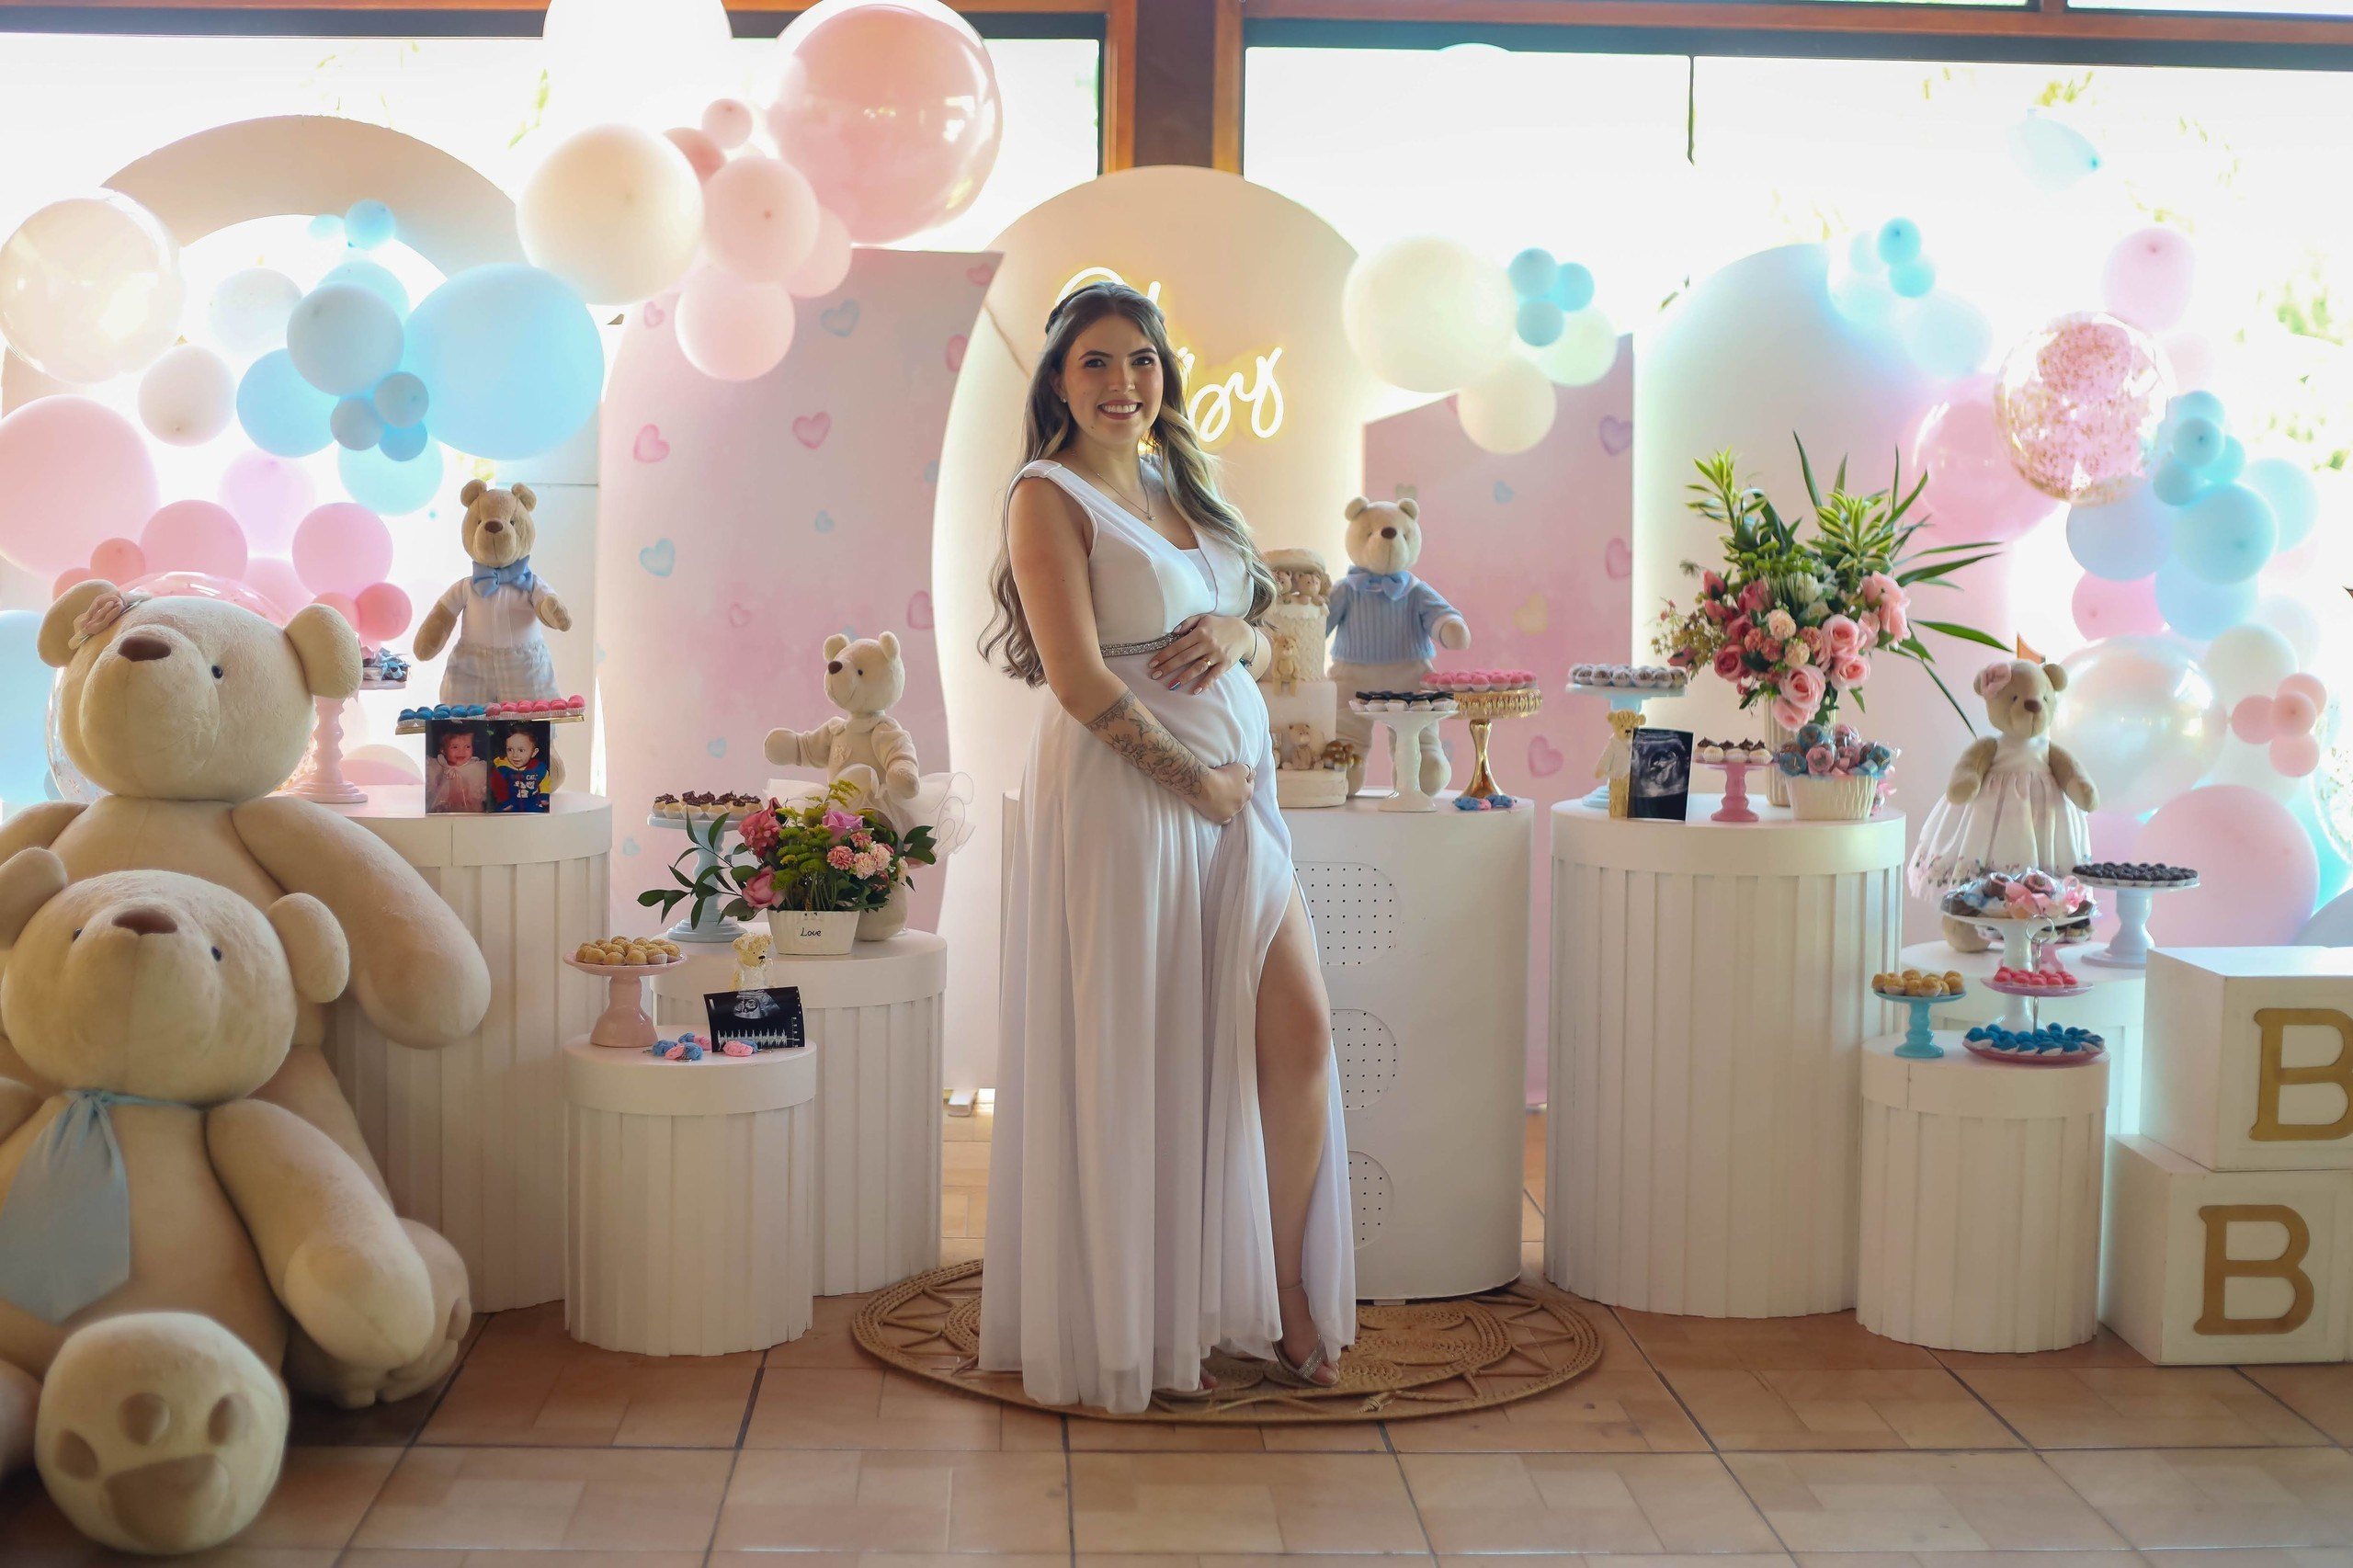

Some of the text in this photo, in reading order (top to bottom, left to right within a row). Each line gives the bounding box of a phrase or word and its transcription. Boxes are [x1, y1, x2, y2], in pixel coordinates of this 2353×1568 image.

[800, 926, 822, 937] Love
[2248, 1007, 2353, 1142] B
[2193, 1204, 2314, 1335] B
